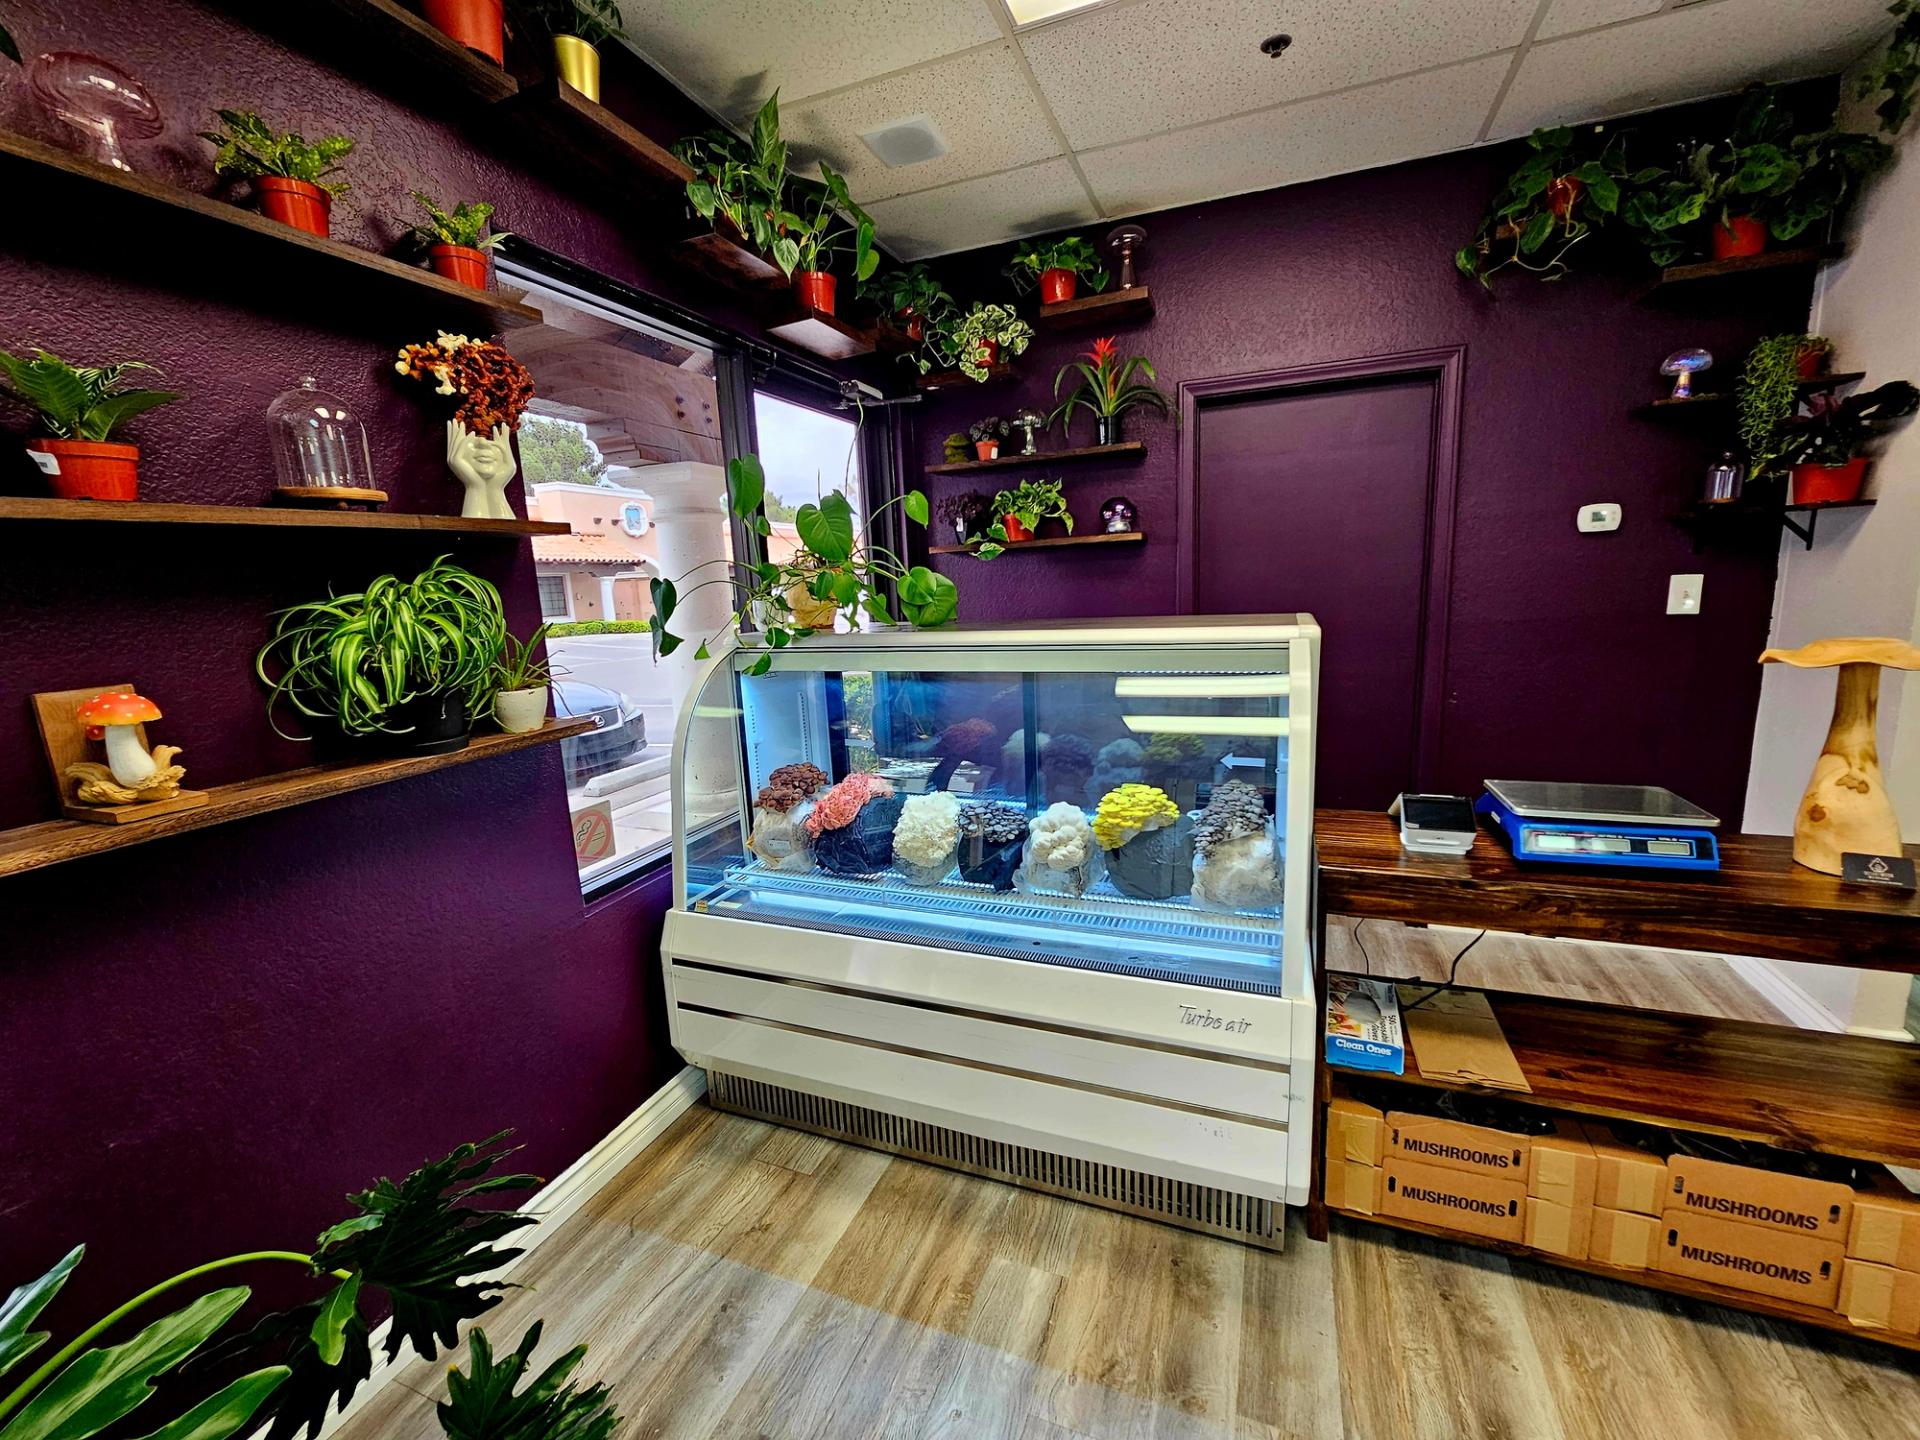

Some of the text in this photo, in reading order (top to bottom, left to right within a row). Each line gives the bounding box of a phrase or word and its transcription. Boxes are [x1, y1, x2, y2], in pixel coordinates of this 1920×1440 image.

[1179, 1004, 1252, 1034] Turbo air
[1335, 1038, 1365, 1051] Clean
[1366, 1043, 1392, 1056] Ones
[1403, 1138, 1509, 1168] MUSHROOMS
[1401, 1185, 1506, 1217] MUSHROOMS
[1685, 1191, 1819, 1230] MUSHROOMS
[1681, 1245, 1812, 1284] MUSHROOMS
